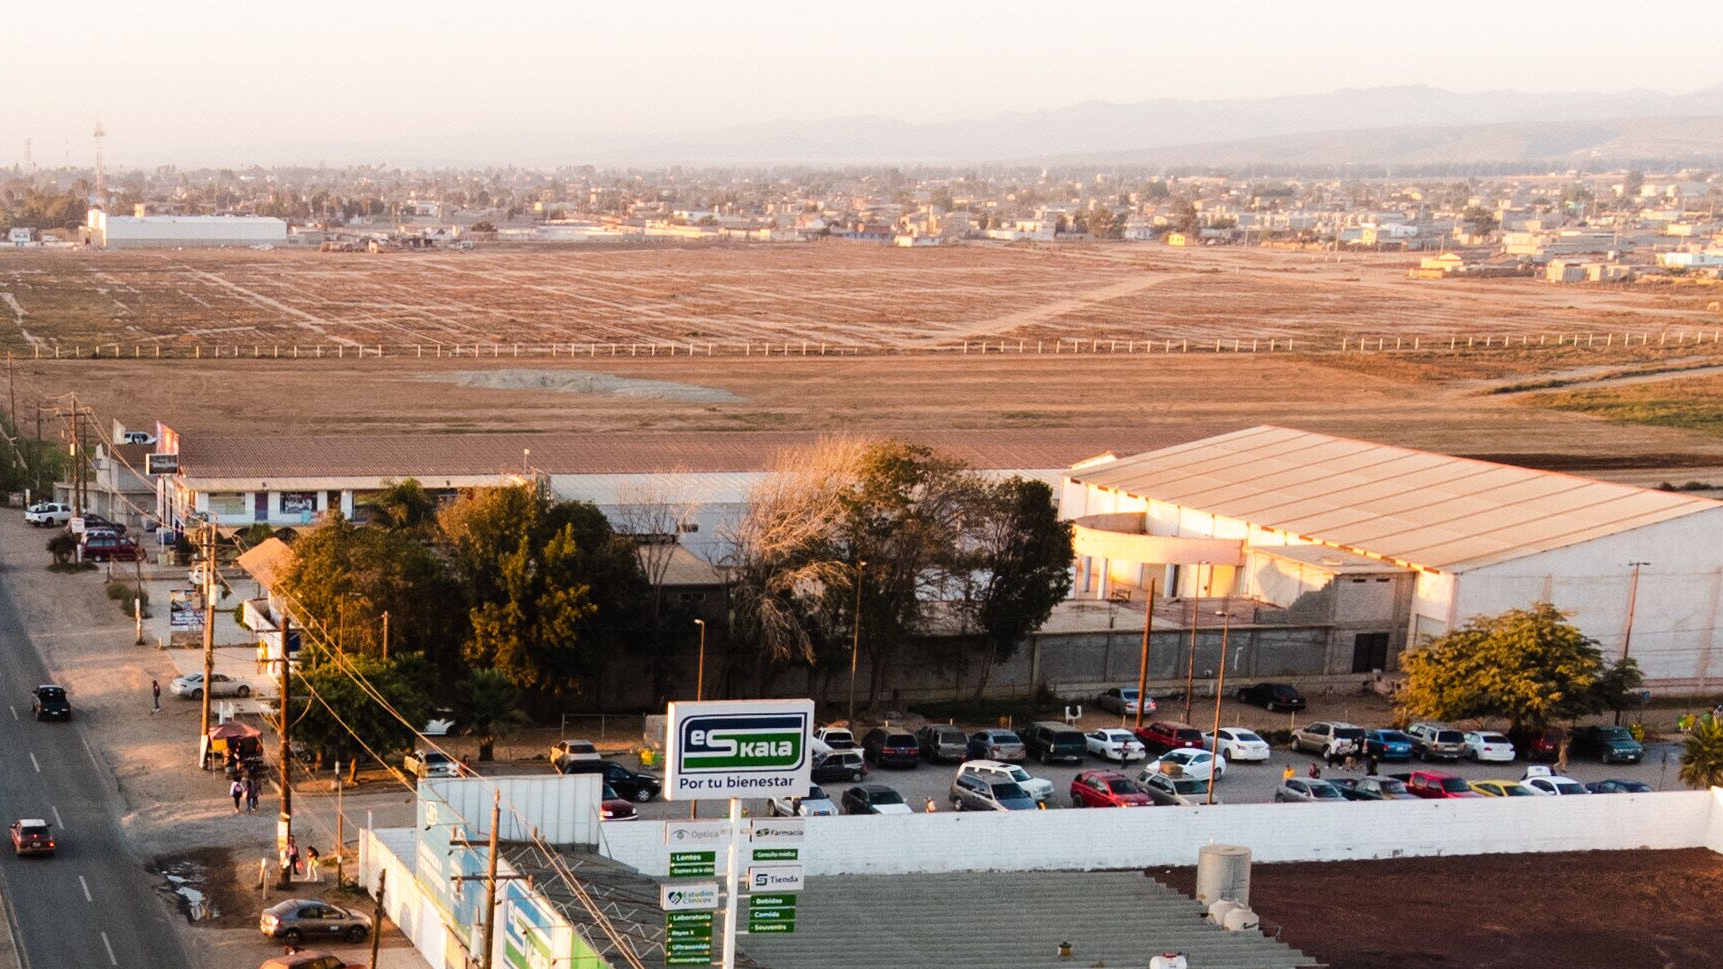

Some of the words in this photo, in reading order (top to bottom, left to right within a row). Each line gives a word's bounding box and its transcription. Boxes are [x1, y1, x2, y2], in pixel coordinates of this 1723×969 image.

[679, 778, 704, 790] Por
[708, 777, 722, 789] tu
[726, 775, 795, 789] bienestar
[770, 828, 804, 837] Farmacia
[770, 875, 799, 884] Tienda
